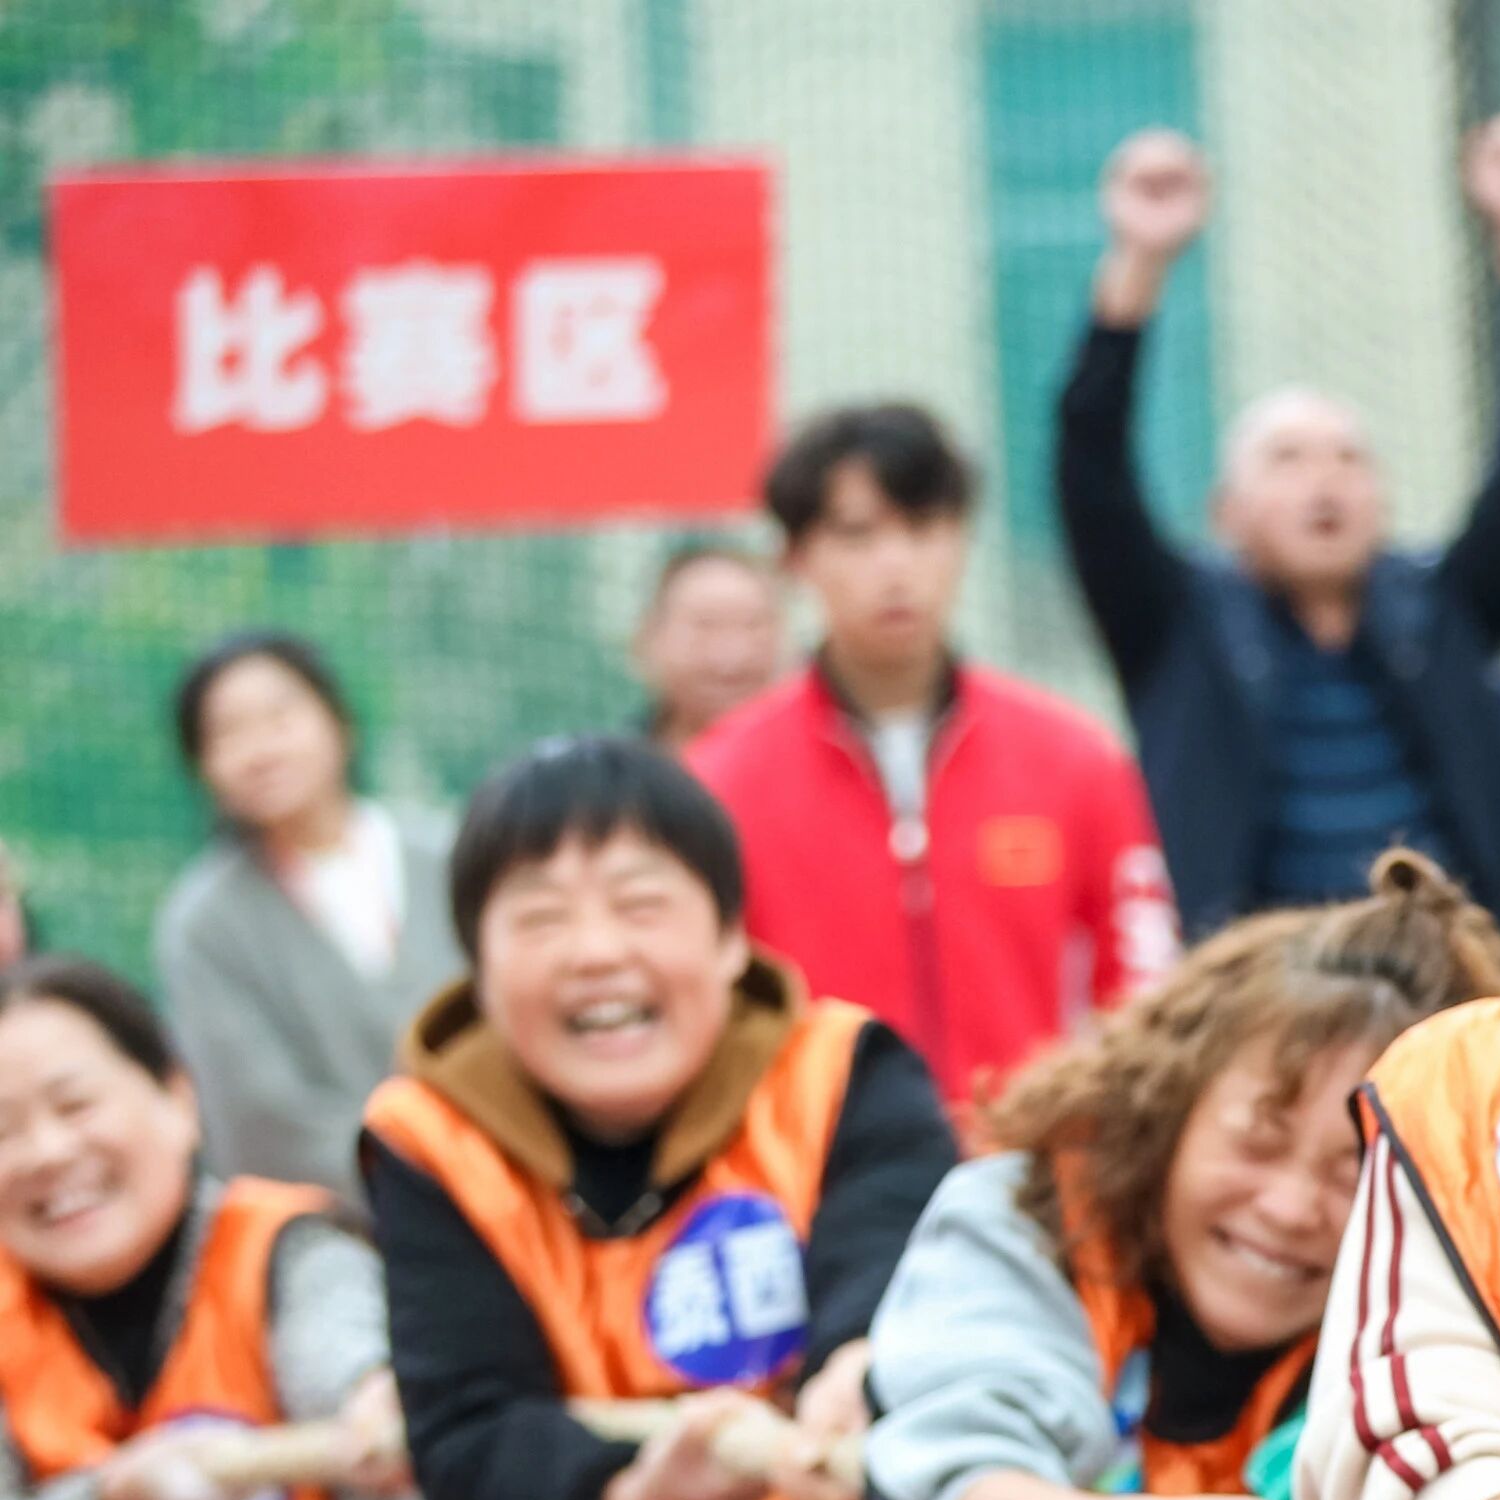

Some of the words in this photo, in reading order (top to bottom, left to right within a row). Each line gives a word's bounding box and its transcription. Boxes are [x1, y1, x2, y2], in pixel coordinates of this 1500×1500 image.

[173, 256, 668, 432] 比赛区
[646, 1221, 808, 1358] 泰西
